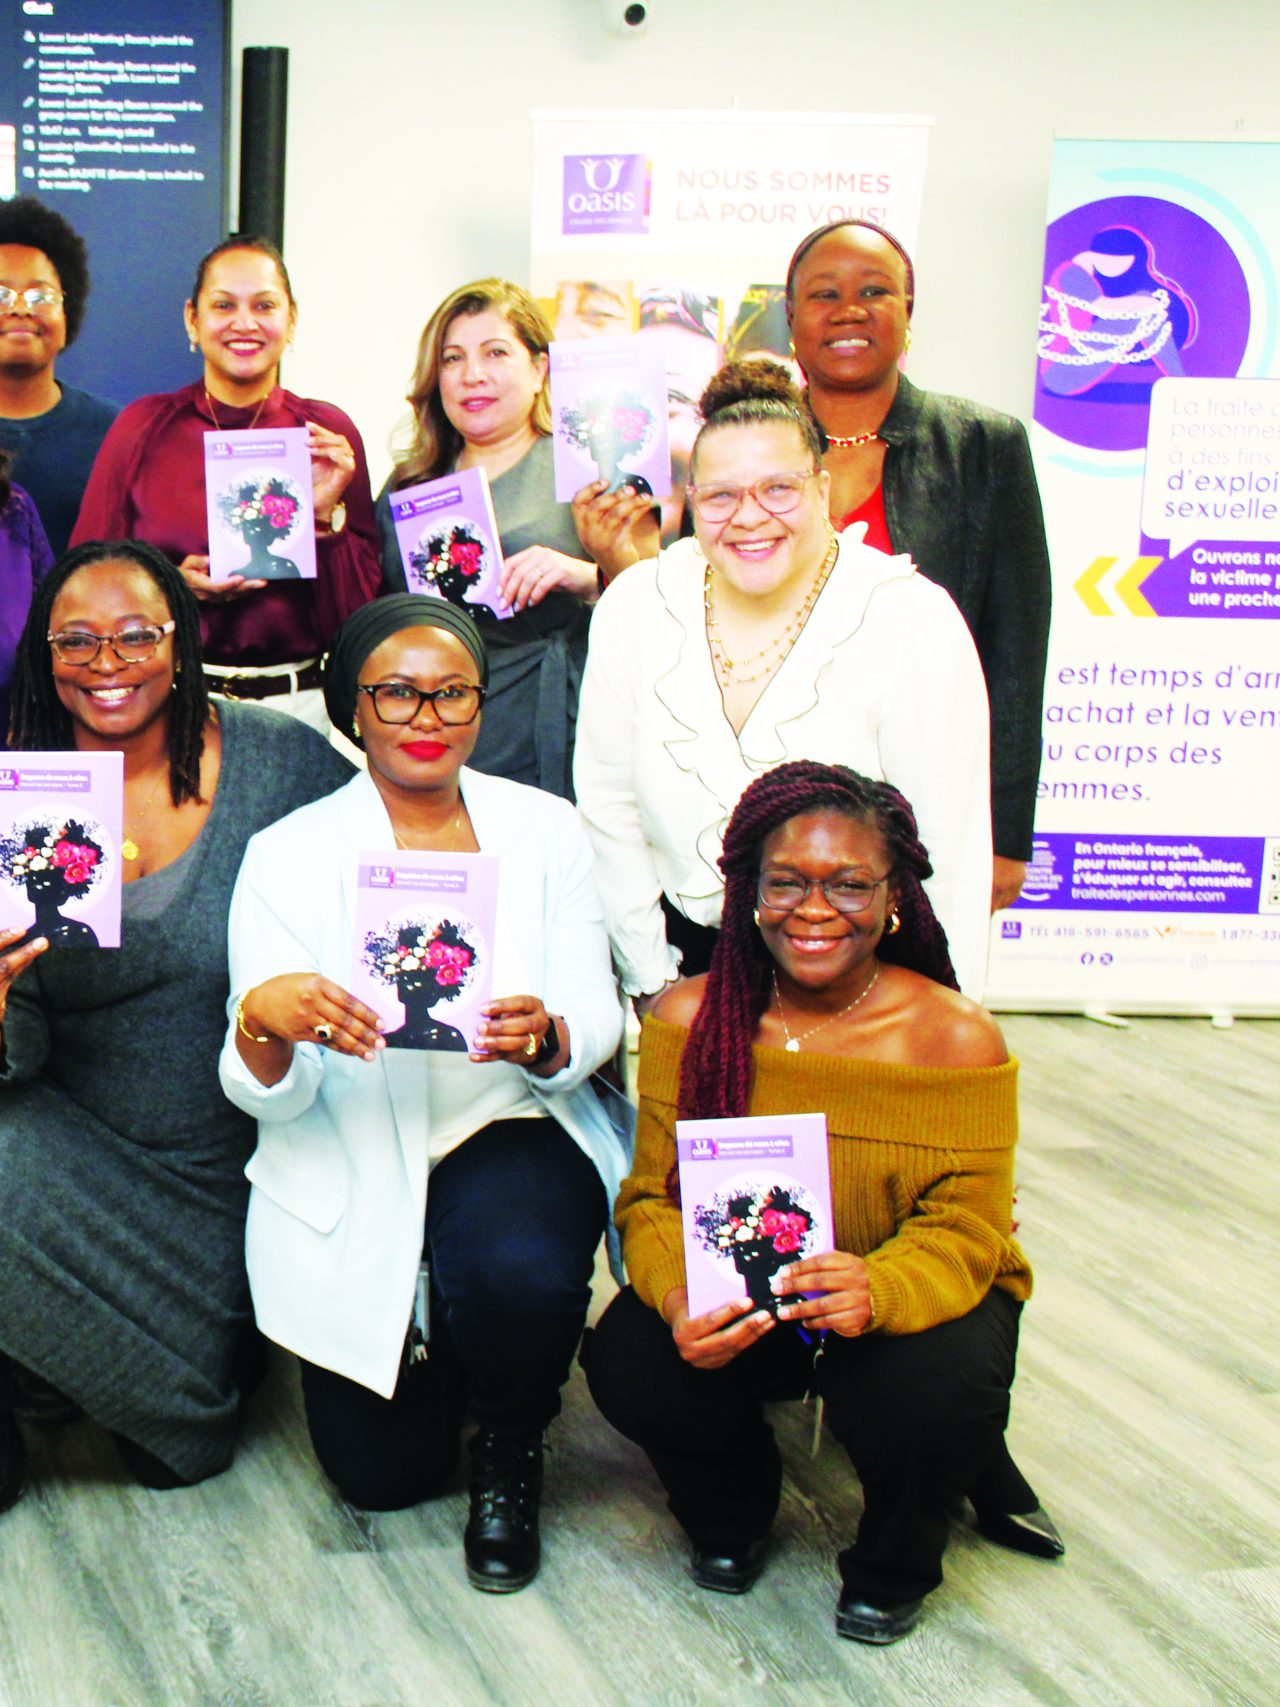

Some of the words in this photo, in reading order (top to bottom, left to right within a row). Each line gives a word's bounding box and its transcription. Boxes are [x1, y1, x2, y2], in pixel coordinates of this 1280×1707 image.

[677, 169, 757, 191] NOUS
[770, 171, 891, 194] SOMMES
[720, 203, 796, 224] POUR
[807, 204, 887, 227] VOUS!
[1173, 397, 1199, 416] La
[1208, 397, 1264, 417] traite
[1191, 448, 1231, 466] des
[1164, 498, 1278, 520] sexuelle
[1192, 547, 1261, 566] Ouvrons
[1190, 568, 1207, 585] la
[1210, 568, 1272, 587] victime
[1188, 592, 1222, 606] une
[1058, 662, 1100, 685] est
[1110, 662, 1203, 693] temps
[1146, 702, 1174, 726] et
[1184, 704, 1210, 727] la
[1222, 709, 1280, 728] ven
[1075, 744, 1158, 768] corps
[1170, 742, 1223, 765] des
[1036, 781, 1151, 801] emmes.
[1075, 841, 1092, 855] En
[1093, 842, 1144, 857] Ontario
[1073, 858, 1105, 873] pour
[1107, 857, 1148, 872] mieux
[1151, 860, 1166, 872] se
[1167, 858, 1245, 875] sensibiliser,
[1141, 874, 1155, 886] et
[1188, 874, 1253, 889] consultez
[1071, 888, 1226, 903] traitedespersonnes.com
[1230, 929, 1280, 941] 877-33
